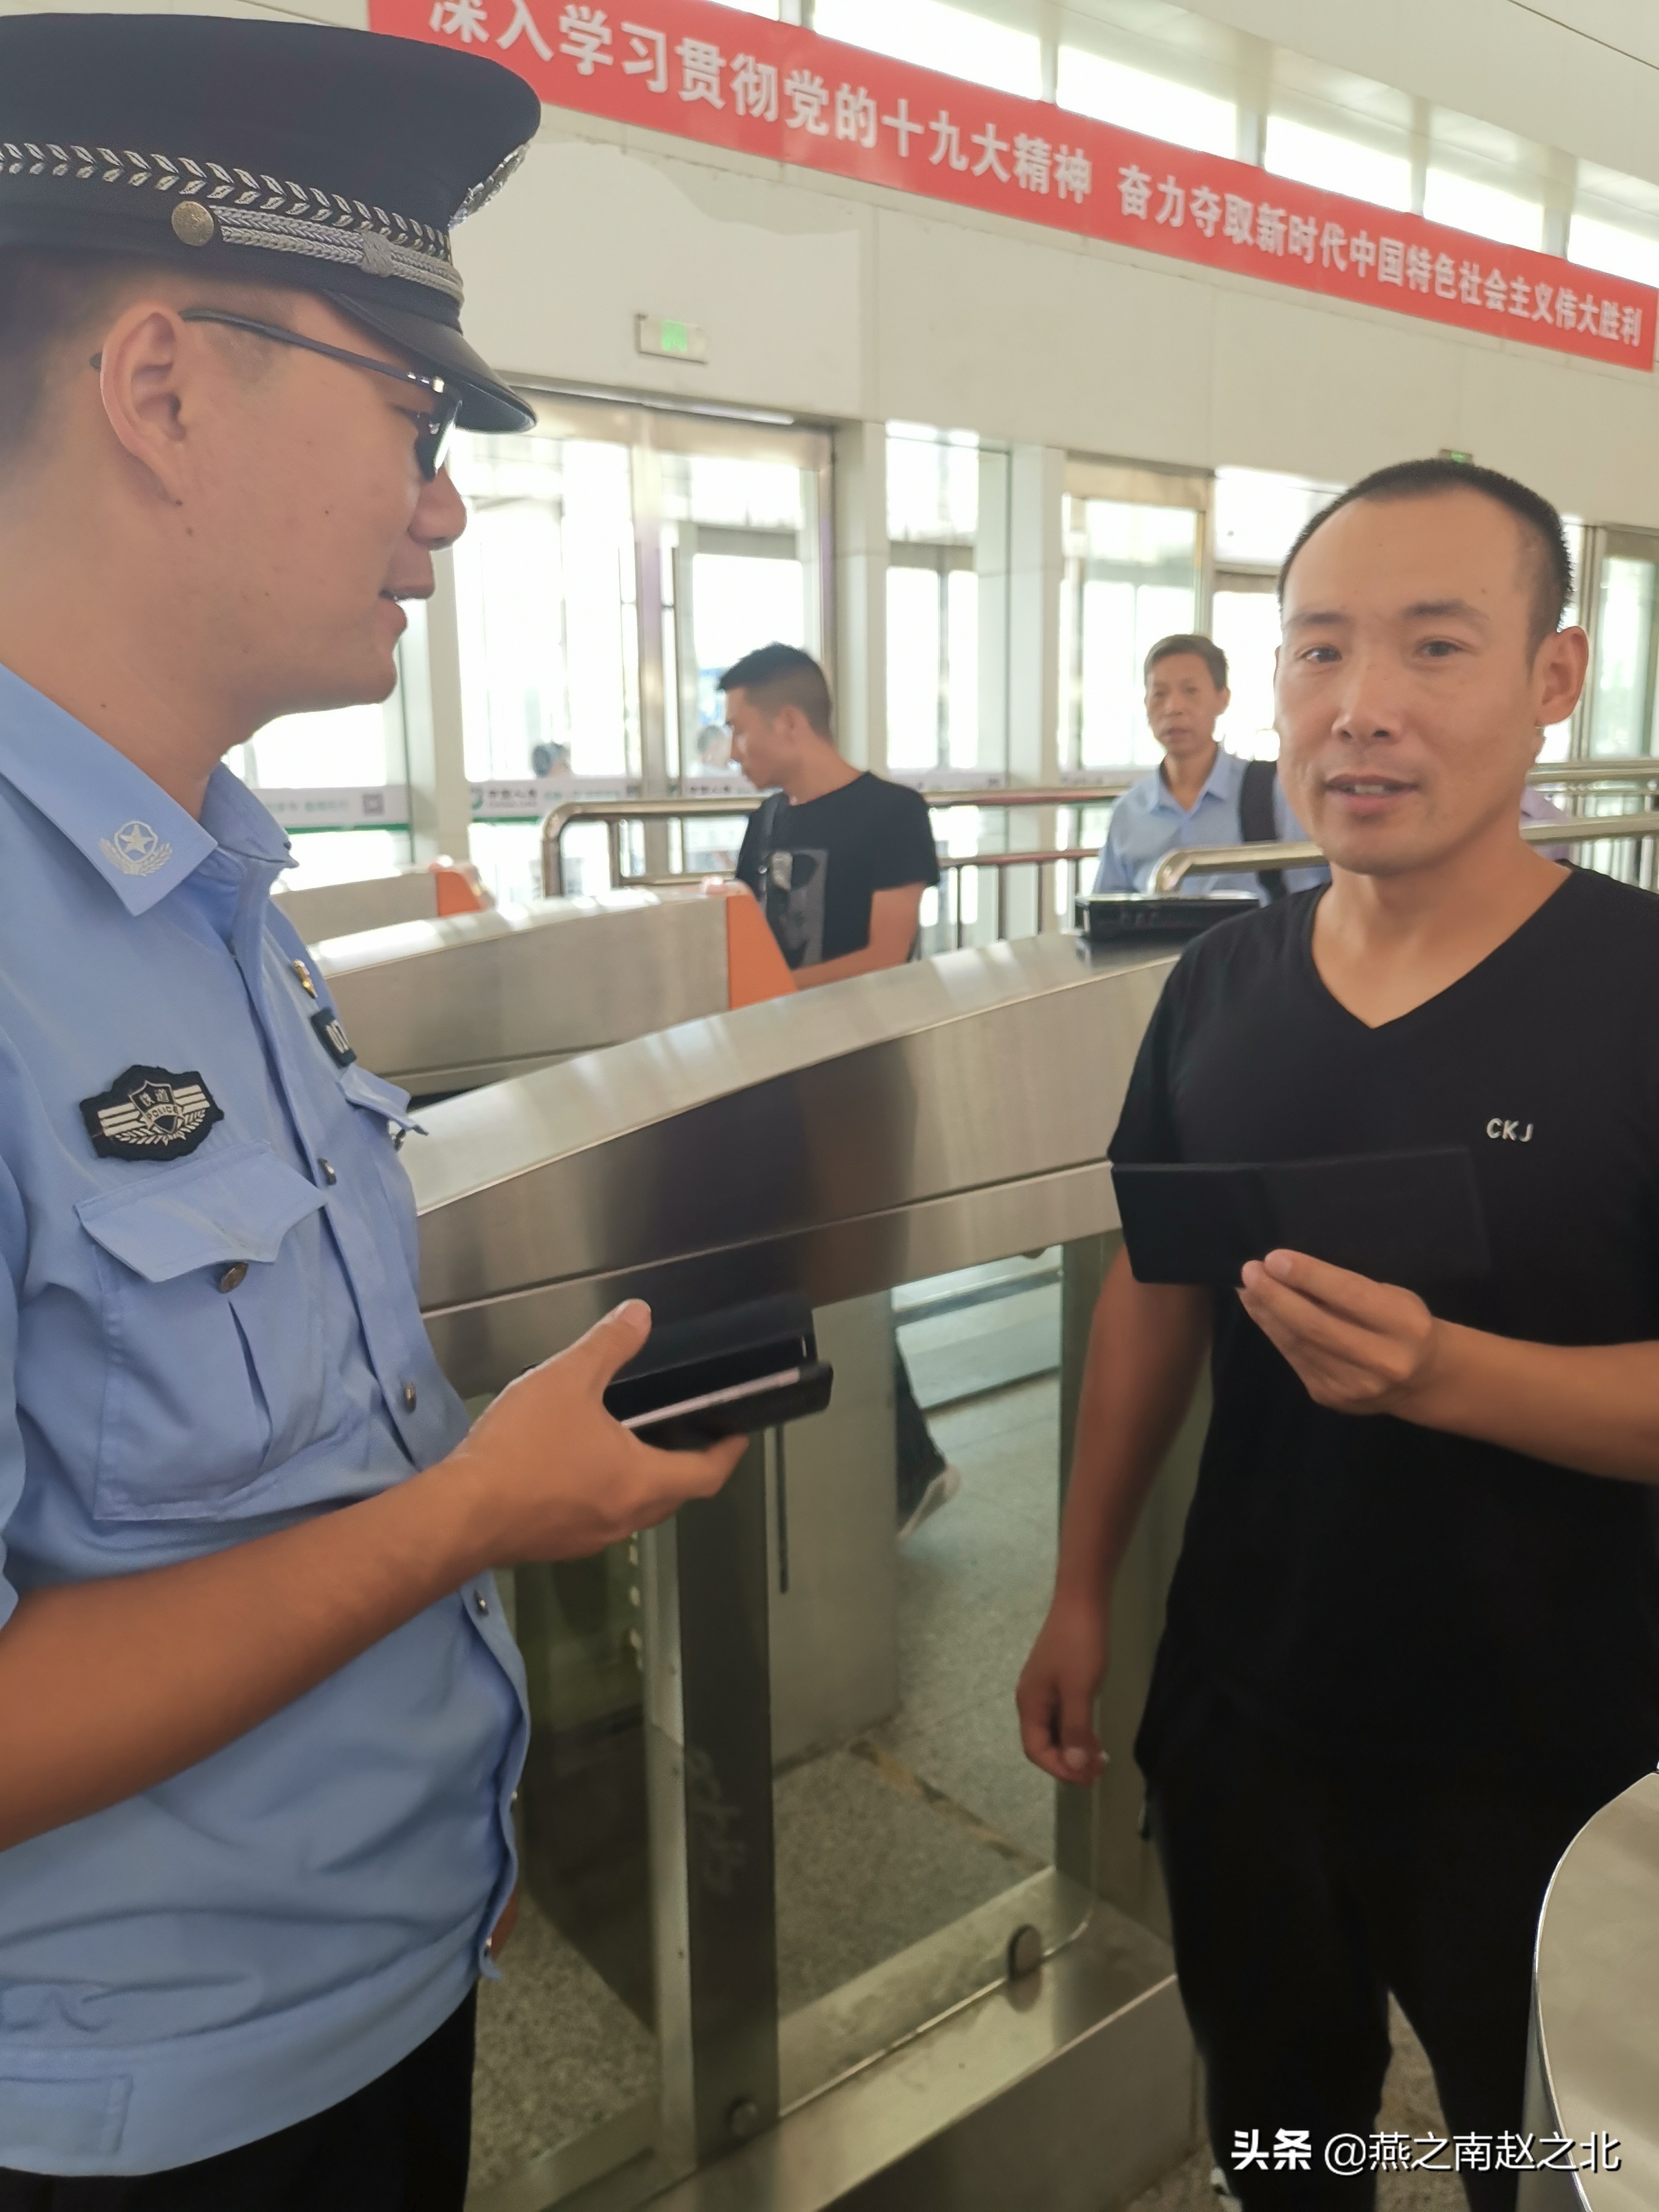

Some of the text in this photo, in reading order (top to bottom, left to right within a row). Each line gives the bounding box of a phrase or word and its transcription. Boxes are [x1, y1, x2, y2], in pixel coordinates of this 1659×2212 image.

[1118, 164, 1643, 347] 奋力夺取新时代中国特色社会主义伟大胜利
[147, 1105, 179, 1120] POLICE
[1486, 1118, 1534, 1142] CKJ
